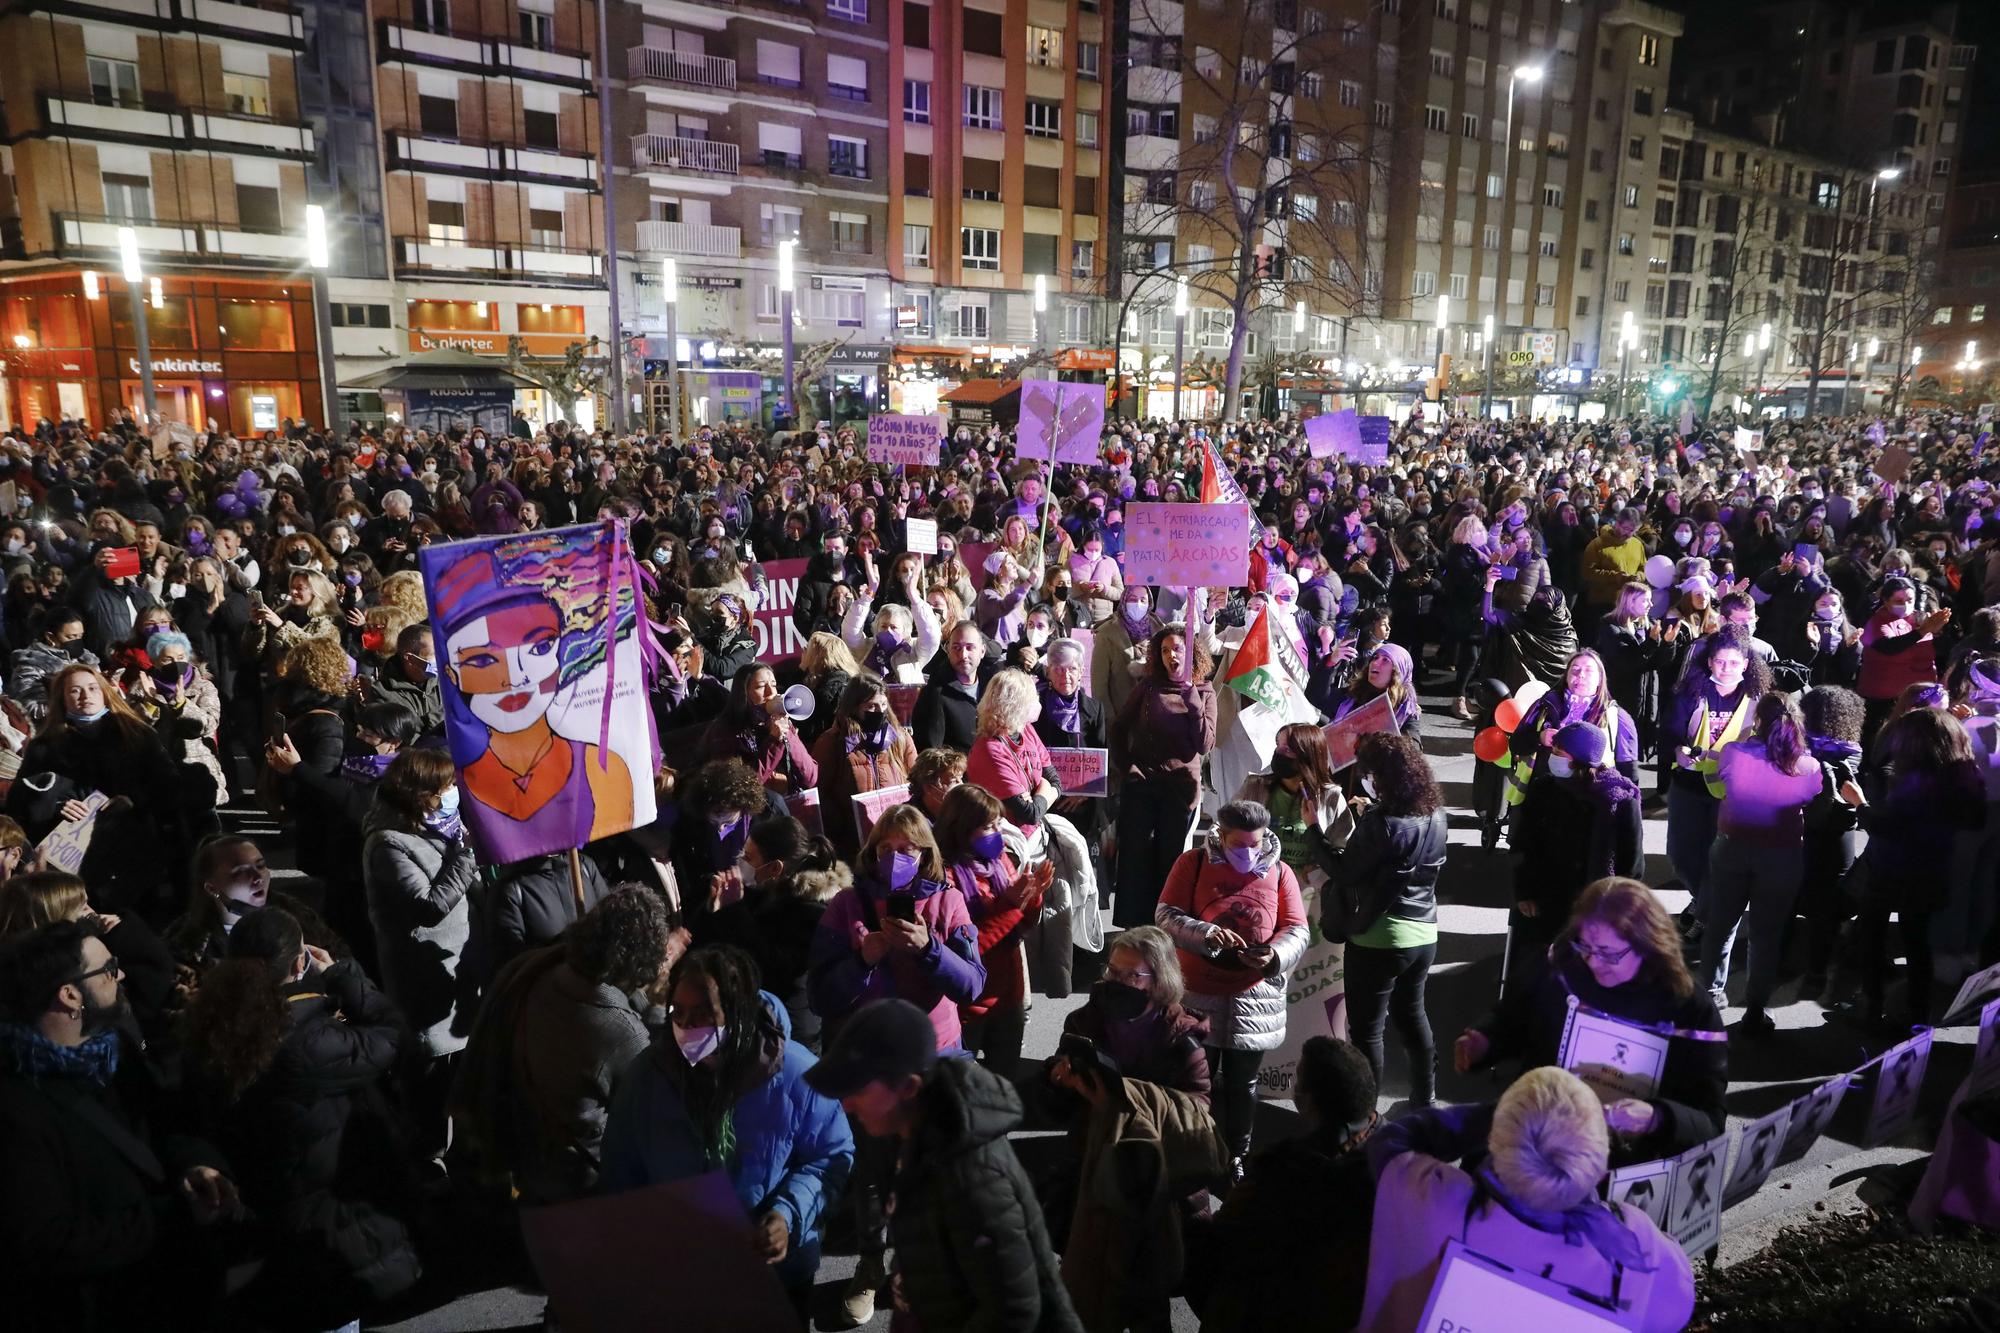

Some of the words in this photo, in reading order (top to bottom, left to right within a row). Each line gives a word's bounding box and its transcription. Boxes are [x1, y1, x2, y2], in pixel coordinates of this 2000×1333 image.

[1510, 352, 1534, 362] ORO
[130, 358, 223, 373] bnkinter.
[430, 388, 474, 397] KIOSCO
[905, 420, 918, 434] ME
[870, 434, 882, 445] EN
[885, 435, 897, 446] 10
[1136, 511, 1156, 525] EL
[1164, 511, 1240, 530] PATRIARCADO
[1170, 529, 1185, 539] ME
[1187, 529, 1202, 539] DA
[1084, 764, 1100, 774] Paz
[1293, 954, 1341, 982] UNA
